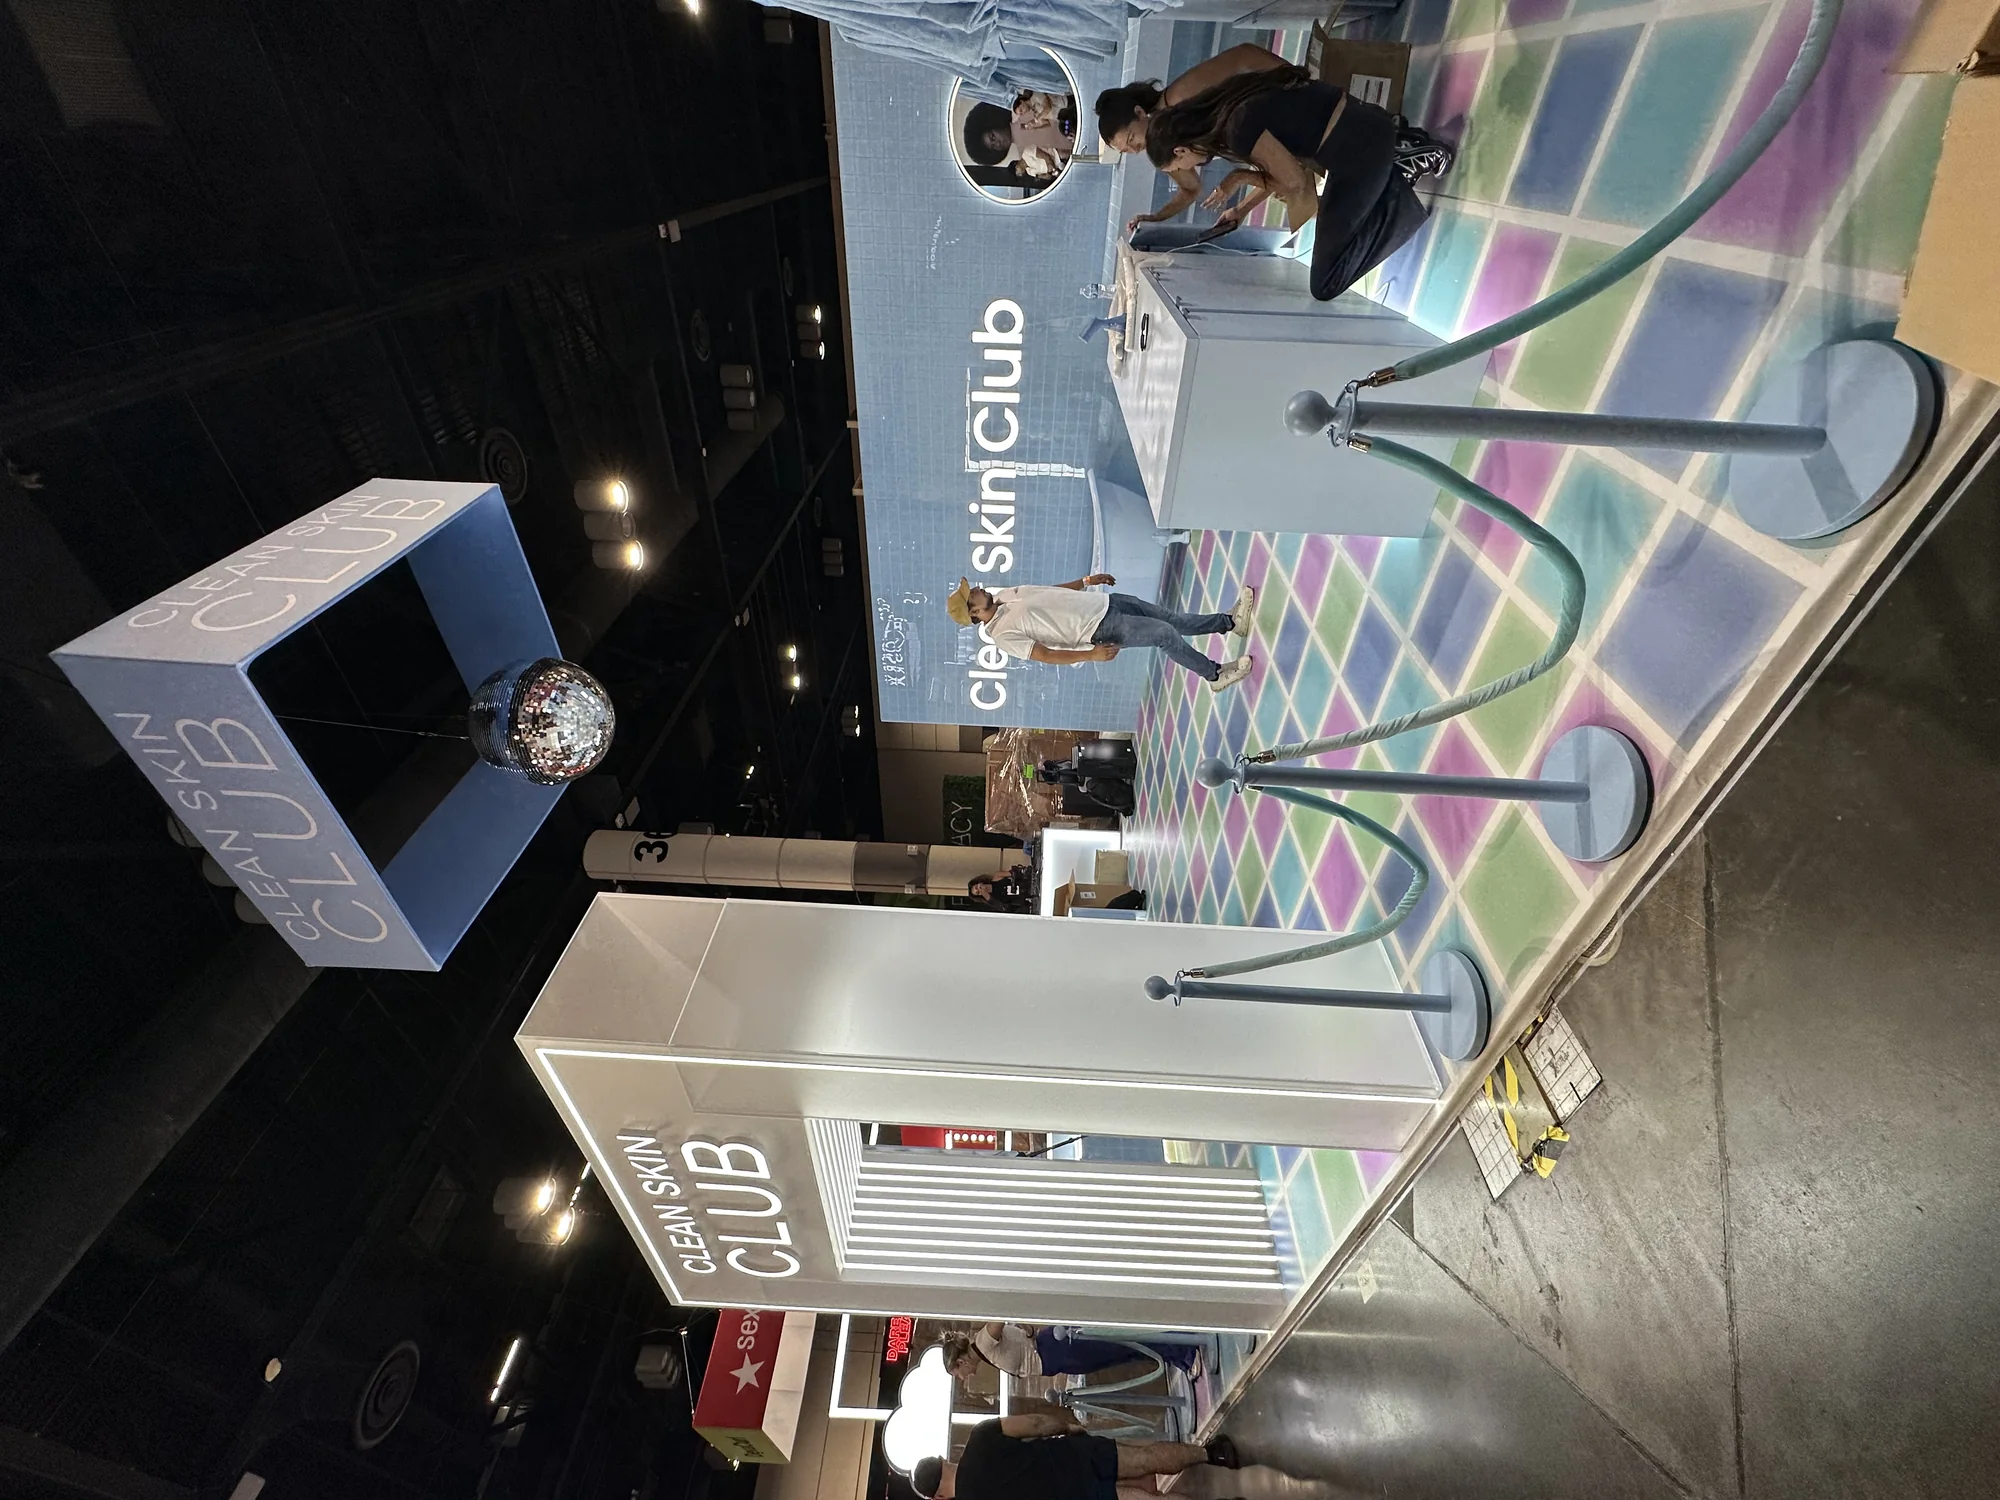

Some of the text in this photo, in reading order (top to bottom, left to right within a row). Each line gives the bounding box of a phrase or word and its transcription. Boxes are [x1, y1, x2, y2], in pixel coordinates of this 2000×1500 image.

[127, 494, 381, 628] CLEAN SKIN
[190, 498, 446, 632] CLUB
[968, 298, 1024, 711] Cle Skin Club
[112, 712, 321, 941] CLEAN SKIN
[174, 717, 388, 943] CLUB
[615, 1134, 717, 1274] CLEAN SKIN
[680, 1140, 801, 1278] CLUB
